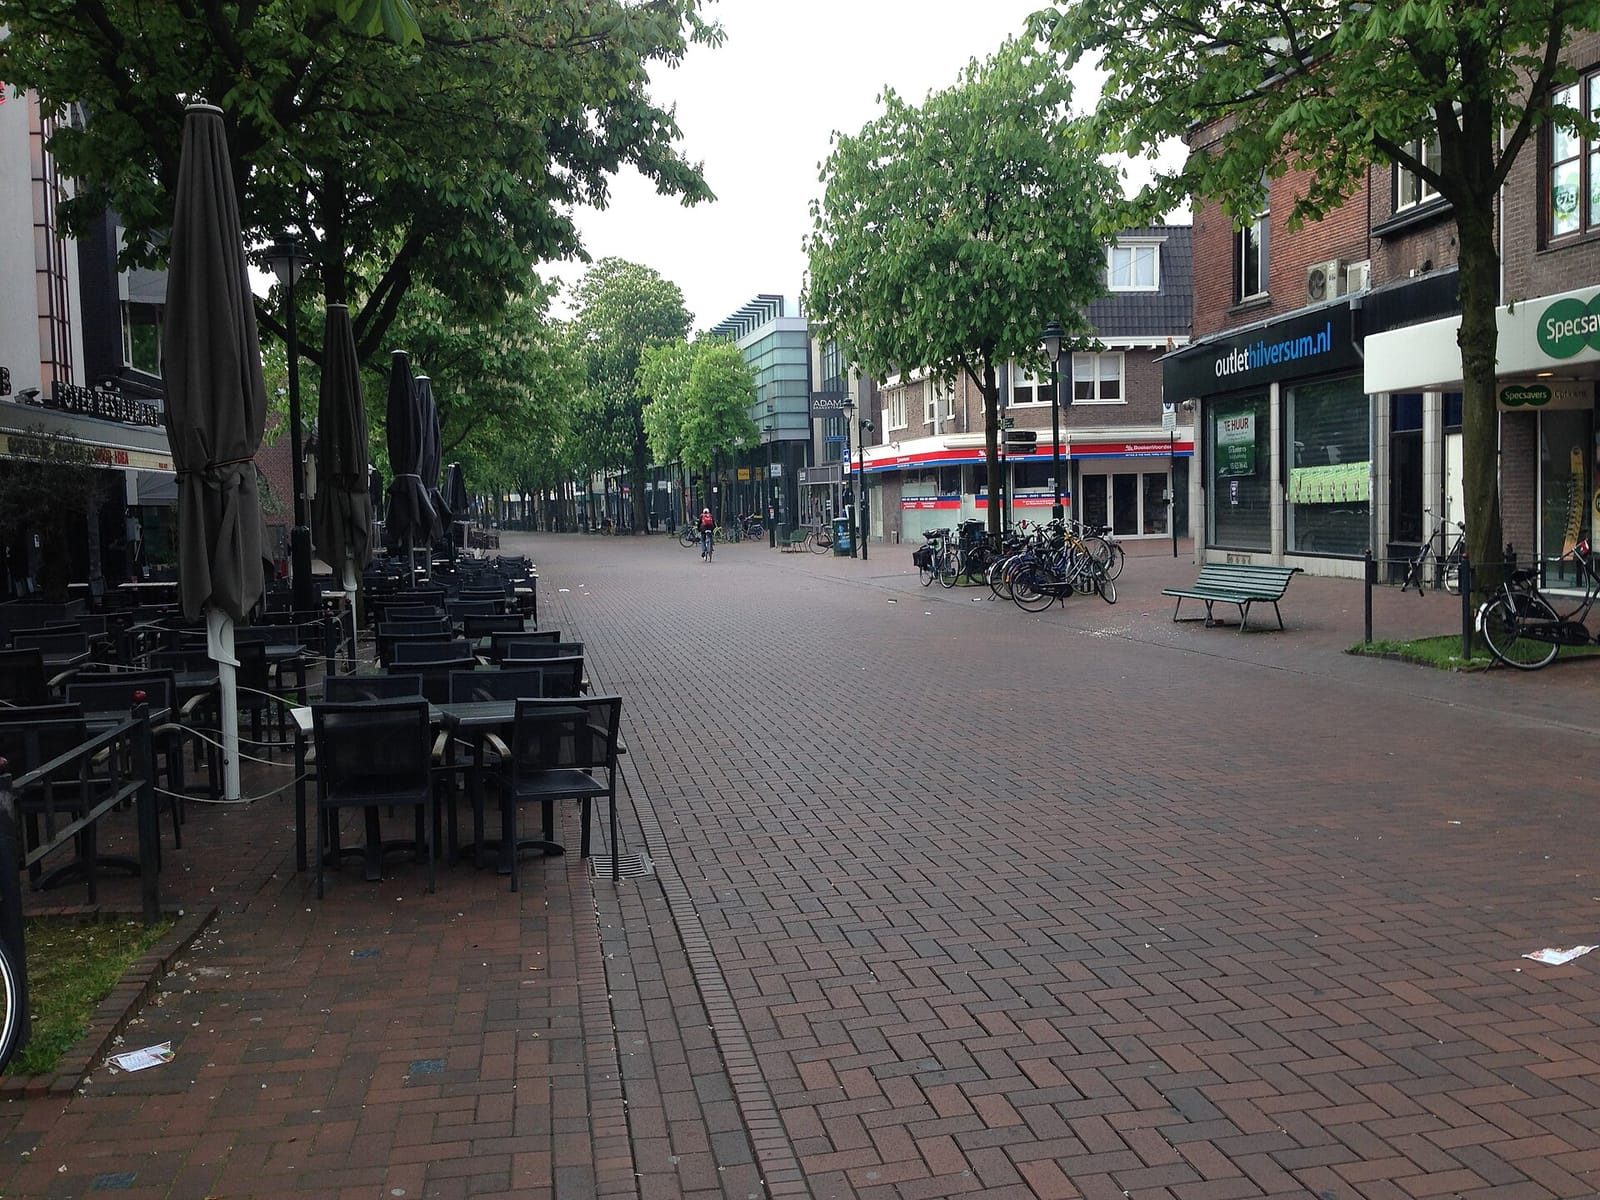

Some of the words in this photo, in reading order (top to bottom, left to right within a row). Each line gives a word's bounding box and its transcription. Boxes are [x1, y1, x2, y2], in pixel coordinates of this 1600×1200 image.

[1546, 314, 1600, 343] Specsa
[1215, 321, 1331, 377] outlethilversum.nl
[57, 382, 94, 412] FOYER
[97, 391, 159, 427] RESTAURANT
[1504, 391, 1547, 400] Specsavers
[1224, 420, 1230, 432] TE
[1231, 417, 1249, 431] HUUR
